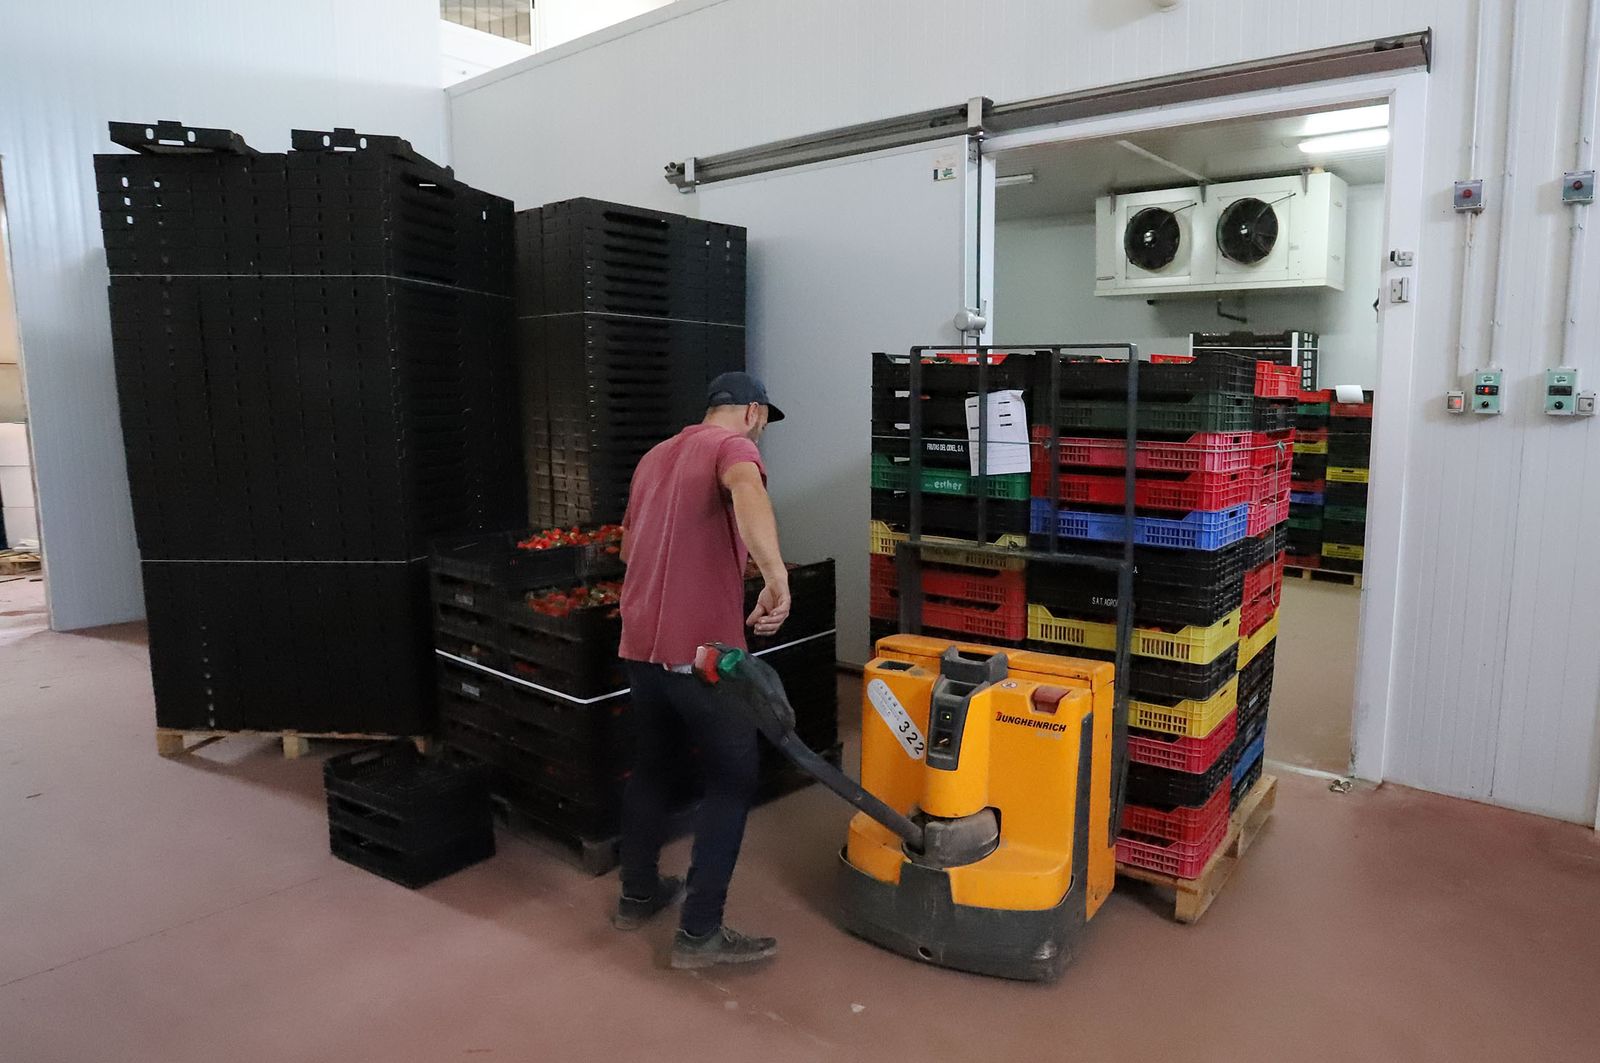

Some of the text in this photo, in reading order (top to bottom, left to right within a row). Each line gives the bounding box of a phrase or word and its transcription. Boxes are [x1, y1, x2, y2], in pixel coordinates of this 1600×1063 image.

[926, 443, 940, 451] FRUTAS
[934, 480, 962, 490] esther
[1104, 598, 1118, 607] AGRO
[995, 711, 1067, 732] JUNGHEINRICH
[899, 721, 925, 755] 322
